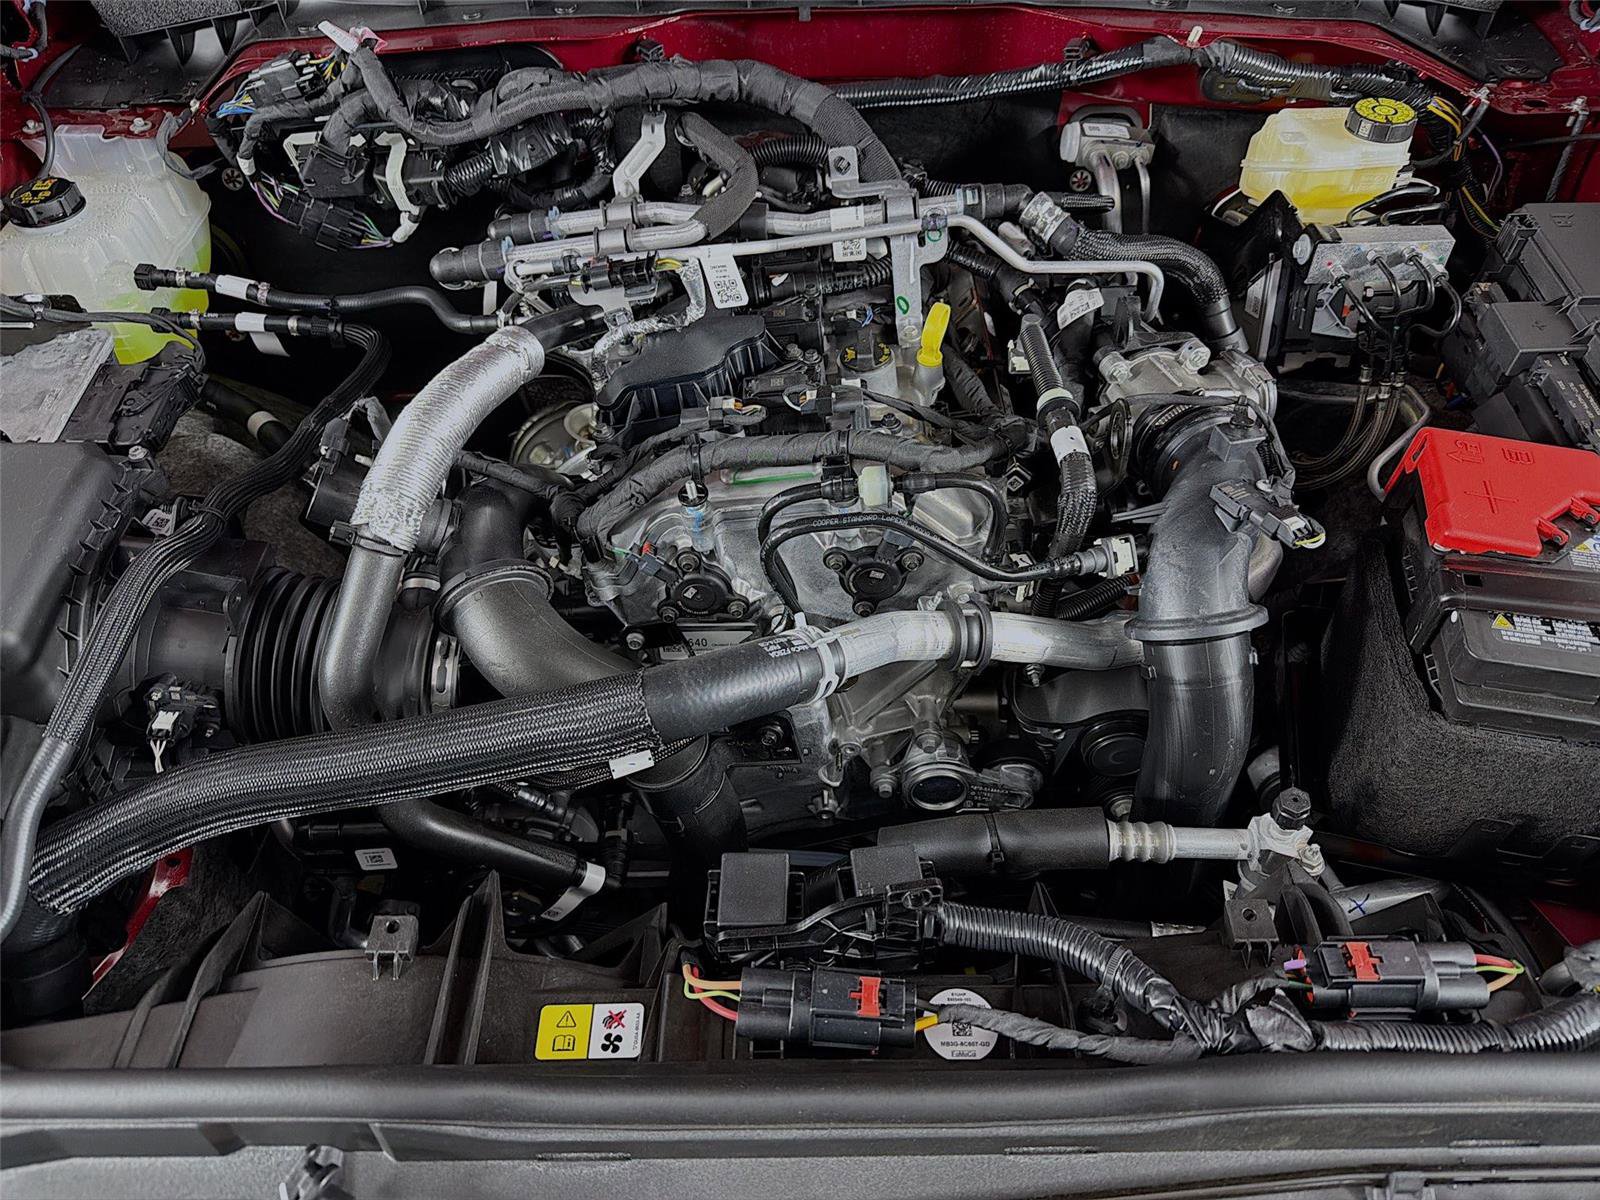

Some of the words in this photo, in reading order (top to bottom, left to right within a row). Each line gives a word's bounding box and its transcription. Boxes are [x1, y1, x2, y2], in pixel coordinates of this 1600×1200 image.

[812, 517, 838, 527] COOPER
[842, 514, 878, 524] STANDARD
[688, 638, 707, 647] 640
